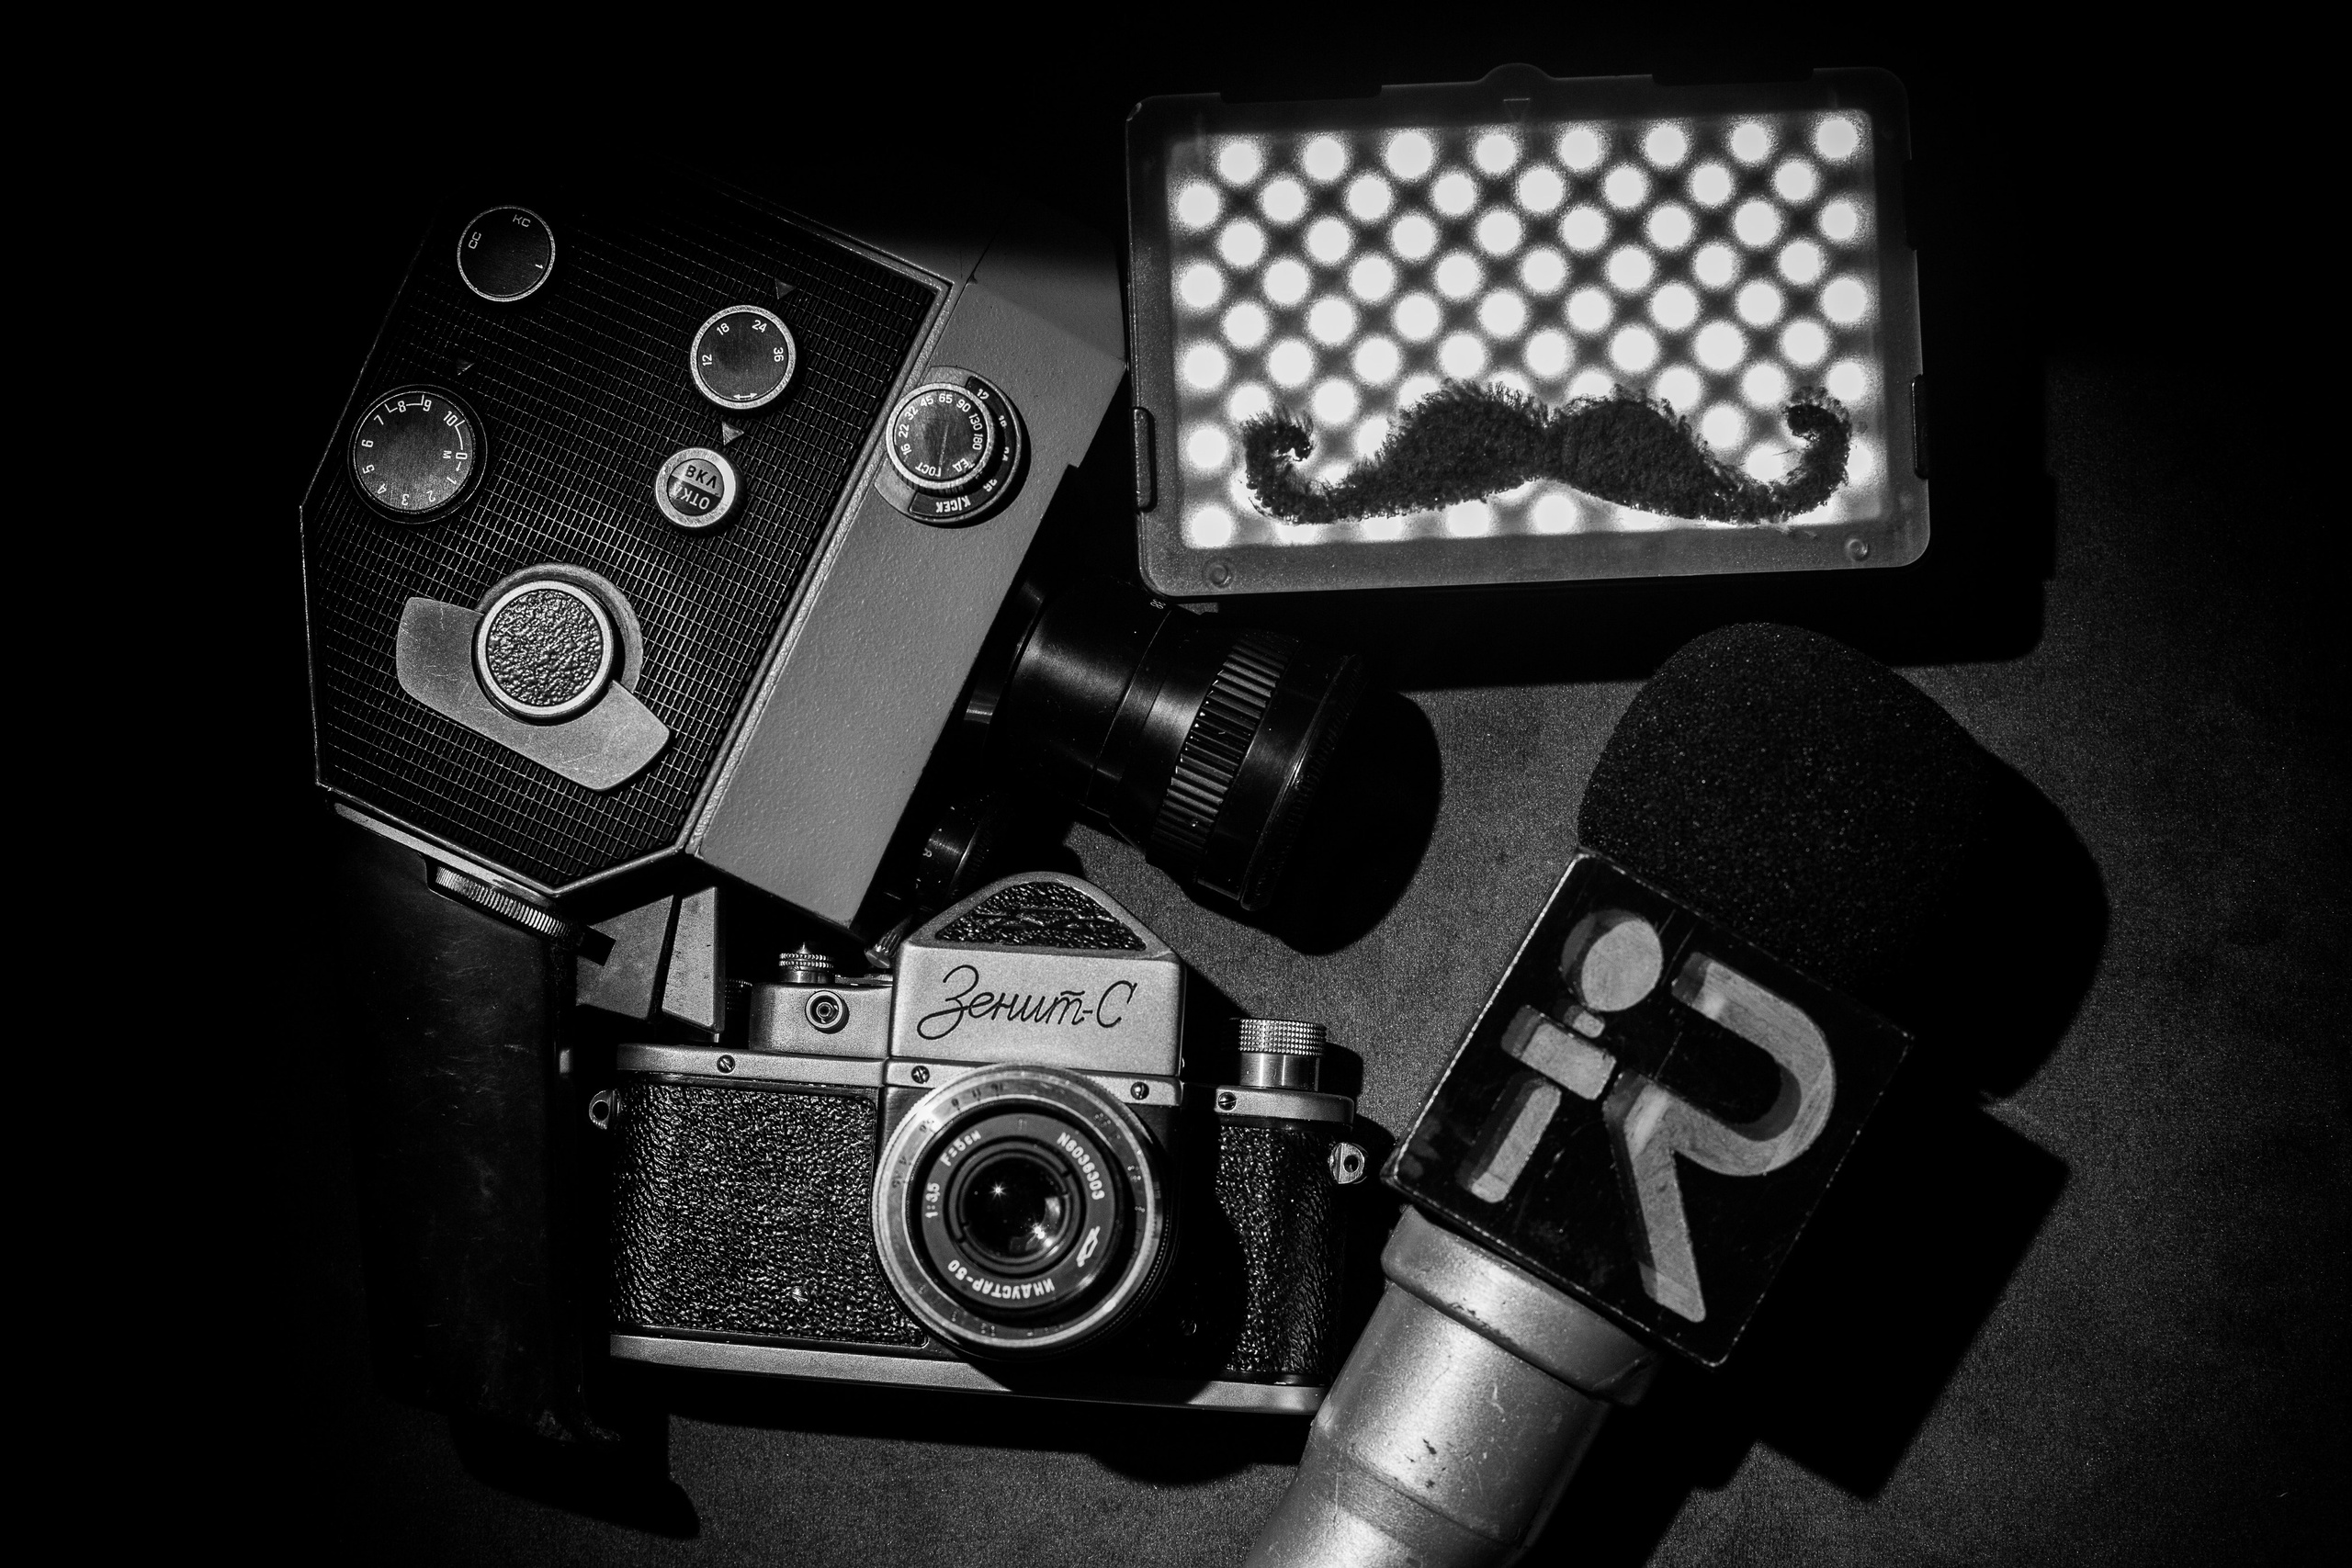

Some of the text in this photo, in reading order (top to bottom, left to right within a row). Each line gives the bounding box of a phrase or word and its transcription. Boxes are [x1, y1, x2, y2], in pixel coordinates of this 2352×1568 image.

[716, 322, 730, 336] 18
[752, 319, 768, 333] 24
[702, 354, 713, 367] 12
[774, 346, 785, 363] 36
[422, 399, 432, 412] 9
[920, 395, 934, 407] 45
[938, 393, 953, 404] 65
[956, 399, 971, 412] 90
[397, 400, 407, 413] 8
[904, 406, 919, 421] 32
[373, 414, 384, 425] 7
[443, 411, 458, 427] 10
[968, 413, 983, 431] 130
[898, 423, 910, 439] 22
[361, 439, 374, 448] 6
[972, 433, 984, 450] 180
[900, 443, 912, 456] 16
[684, 464, 718, 489] ВКЛ
[915, 461, 942, 478] ГОСТ
[916, 964, 1138, 1041] Зенит-С
[947, 1259, 1056, 1300] ИНДУСТАР-50
